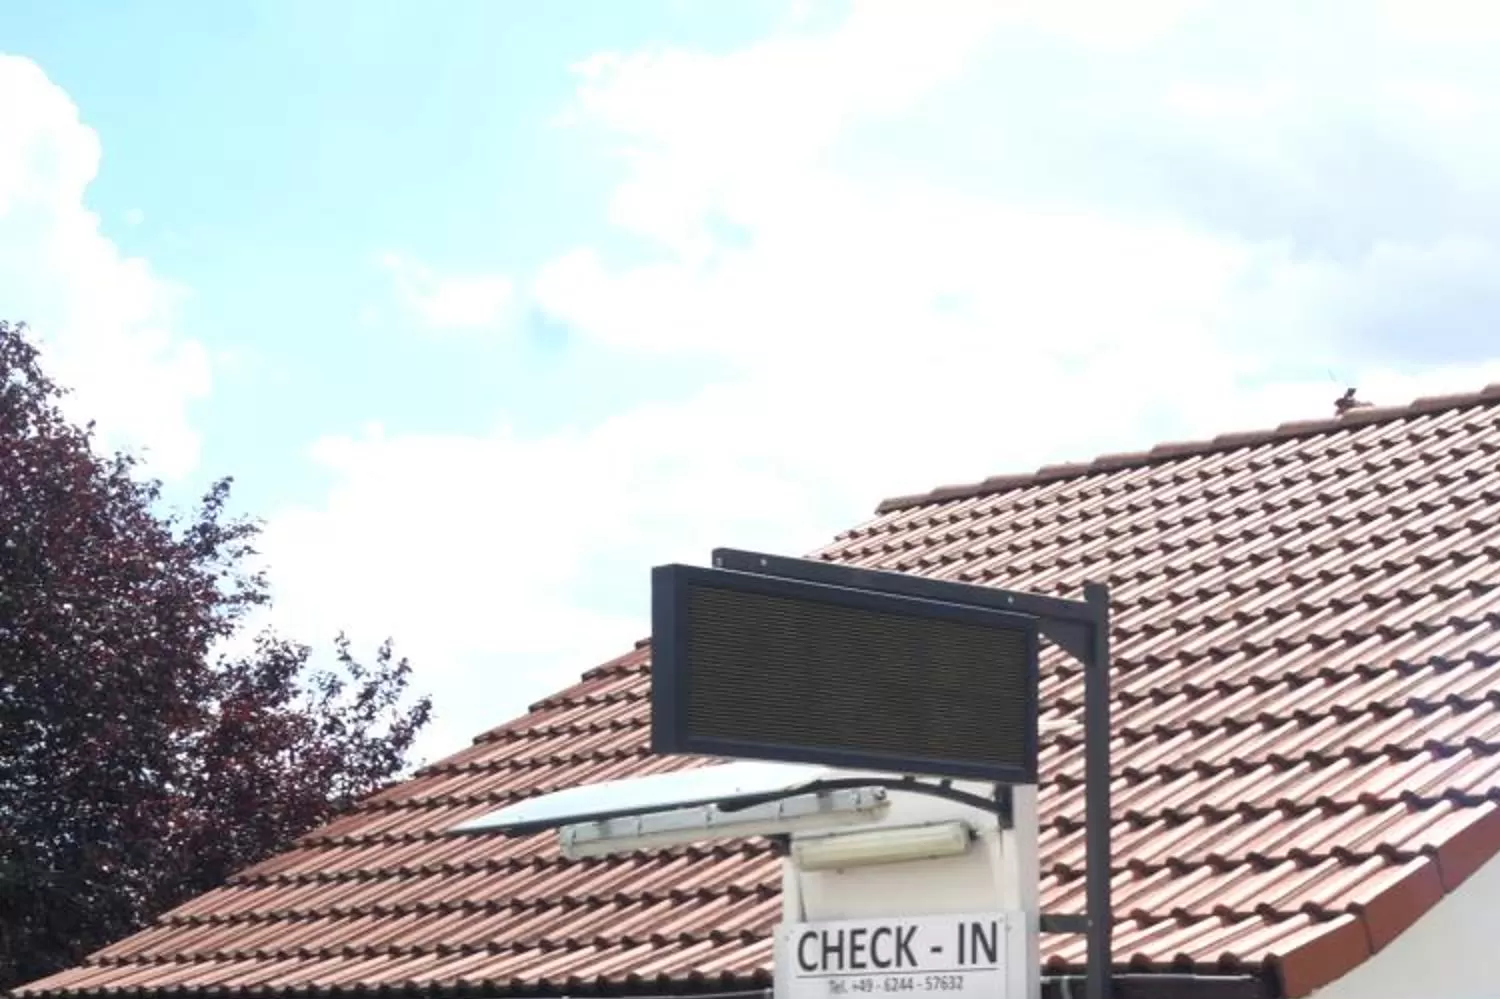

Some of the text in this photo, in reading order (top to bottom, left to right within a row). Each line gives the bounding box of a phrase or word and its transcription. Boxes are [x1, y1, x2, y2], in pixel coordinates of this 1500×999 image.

[797, 925, 918, 972] CHECK
[958, 921, 998, 965] IN
[828, 979, 848, 995] Tel.
[851, 977, 873, 992] +49
[883, 977, 914, 993] 6244
